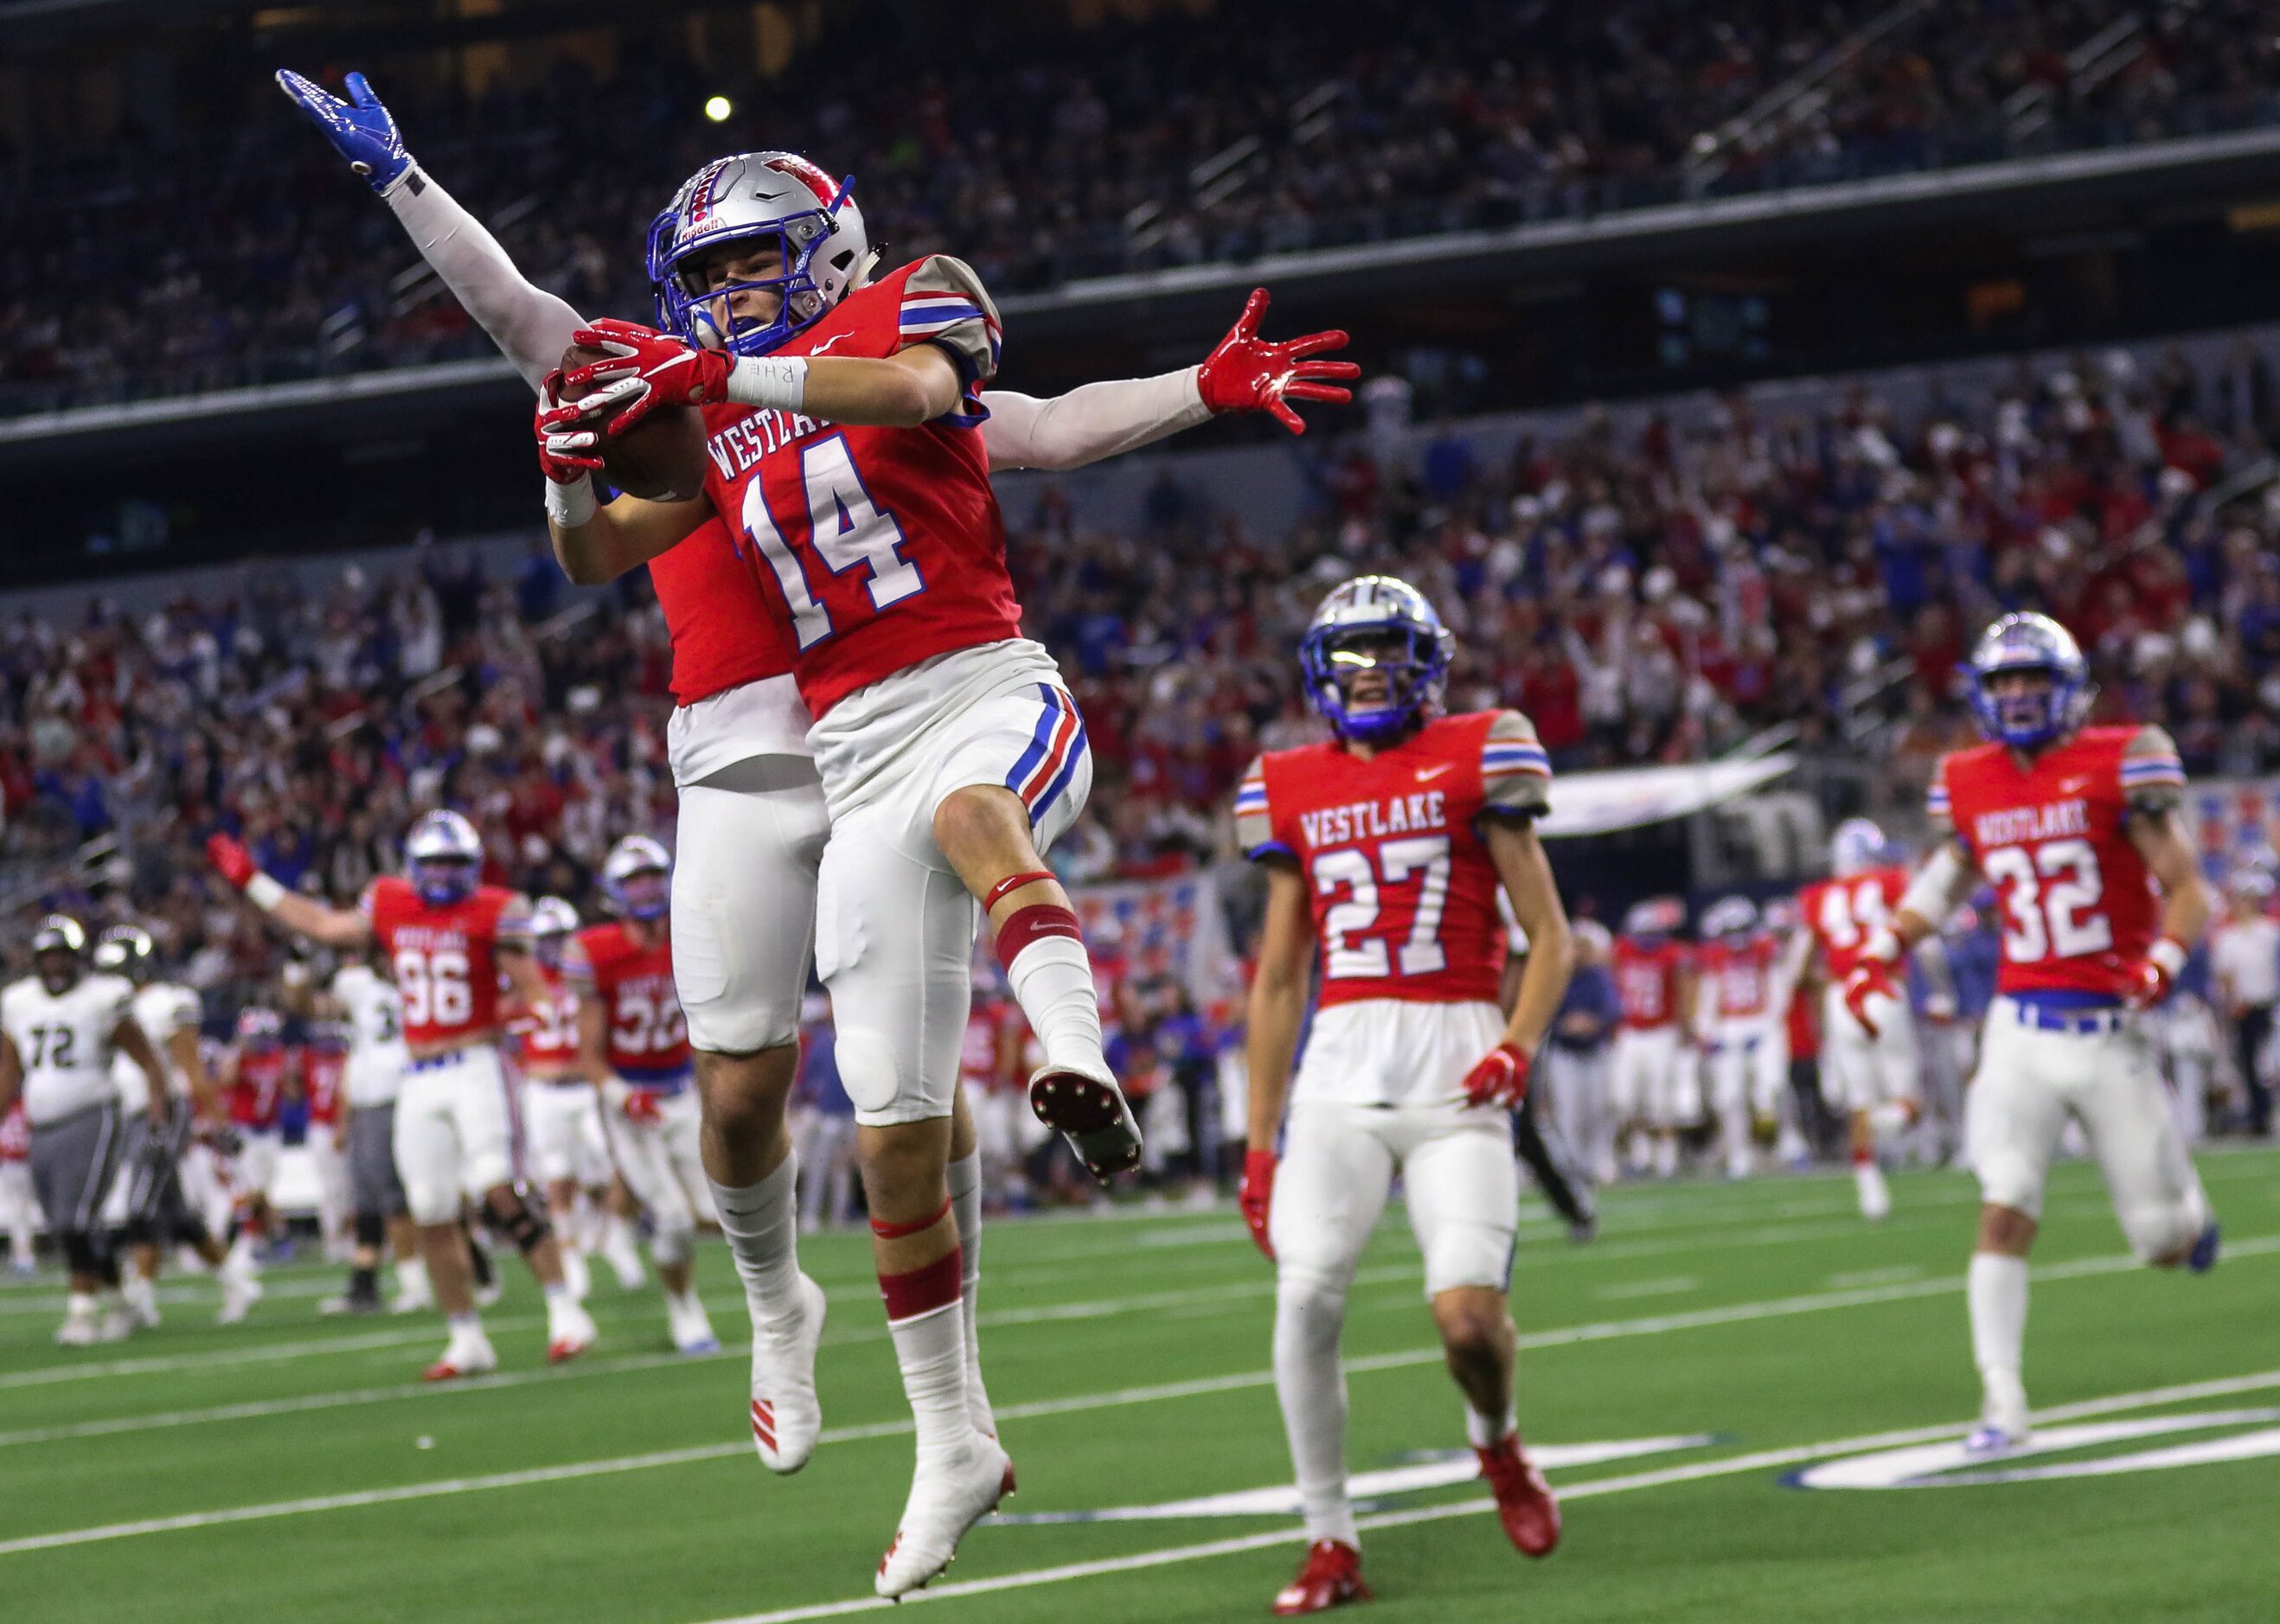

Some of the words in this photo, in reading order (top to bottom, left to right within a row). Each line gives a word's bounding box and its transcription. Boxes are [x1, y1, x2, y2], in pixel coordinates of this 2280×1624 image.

[707, 407, 830, 481] WESTLA
[740, 432, 927, 653] 14
[1300, 790, 1447, 849] WESTLAKE
[1311, 834, 1451, 980] 27
[1983, 838, 2114, 964] 32
[393, 949, 472, 1026] 96
[29, 1025, 76, 1068] 72
